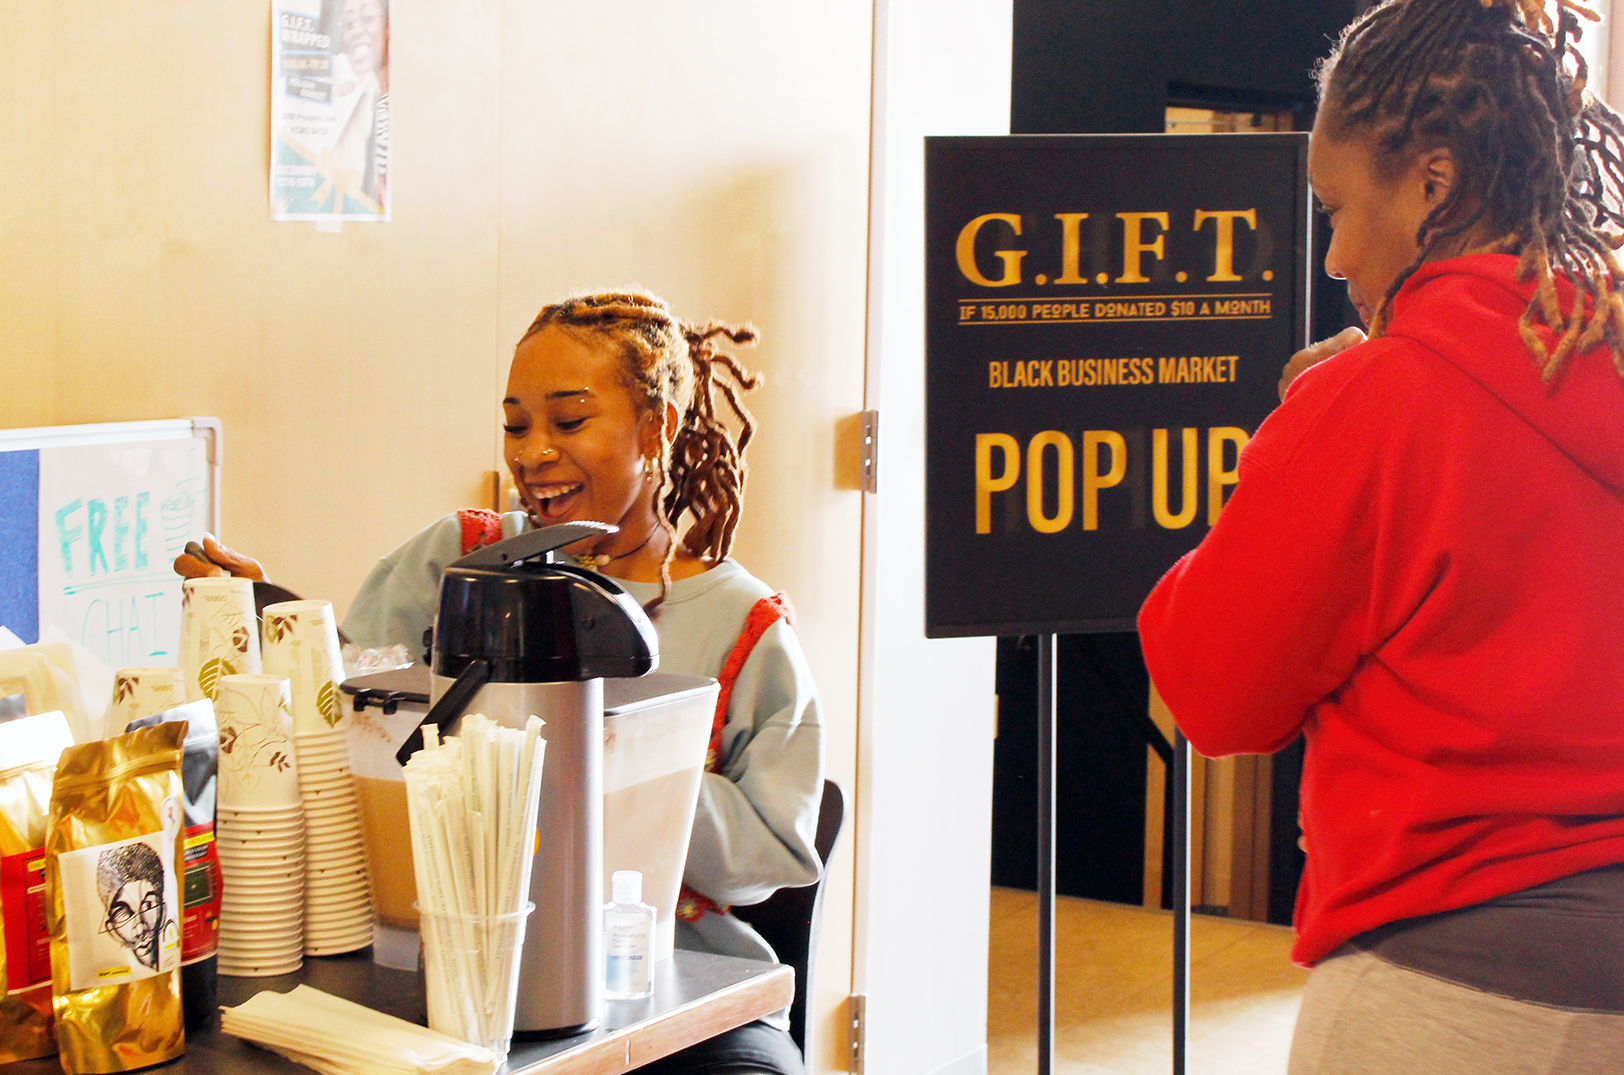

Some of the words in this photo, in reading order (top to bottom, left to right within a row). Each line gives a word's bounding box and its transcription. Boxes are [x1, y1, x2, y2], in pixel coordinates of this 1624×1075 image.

[955, 208, 1274, 288] G.I.F.T.
[959, 305, 976, 321] IF
[980, 304, 1028, 321] 15,000
[1032, 303, 1090, 319] PEOPLE
[1094, 301, 1166, 318] DONATED
[1171, 300, 1195, 317] $10
[1199, 302, 1211, 315] A
[1214, 299, 1272, 316] MONTH
[988, 360, 1054, 389] BLACK
[1057, 357, 1154, 387] BUSINESS
[1158, 355, 1240, 384] MARKET
[975, 429, 1127, 535] POP
[1152, 426, 1250, 531] UP
[54, 491, 150, 579] FREE
